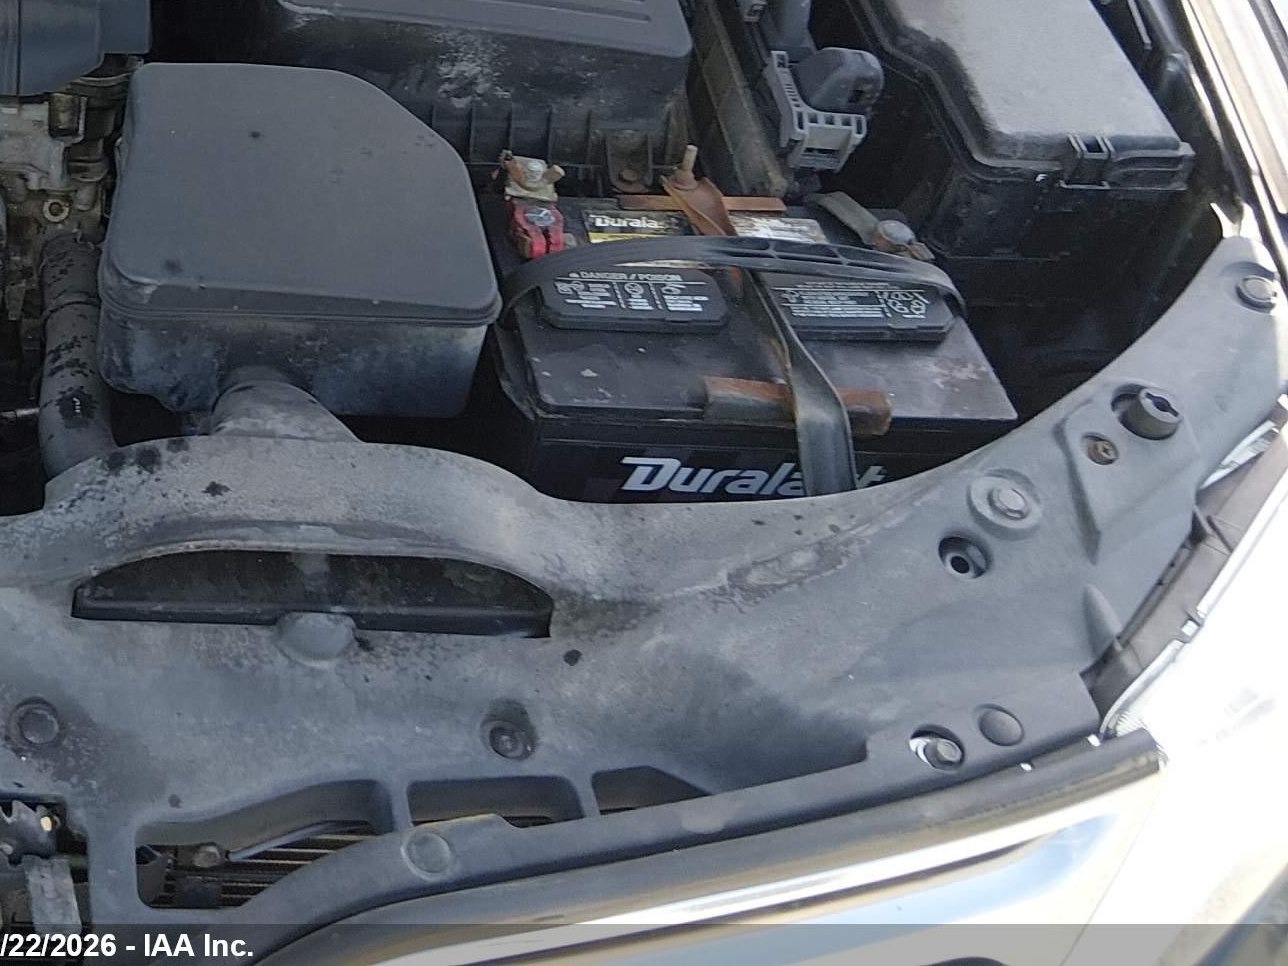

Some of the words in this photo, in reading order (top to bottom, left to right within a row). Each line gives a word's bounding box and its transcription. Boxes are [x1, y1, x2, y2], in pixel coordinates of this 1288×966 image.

[579, 271, 627, 281] DANGER
[637, 273, 683, 282] POISON
[620, 456, 887, 497] Duralat
